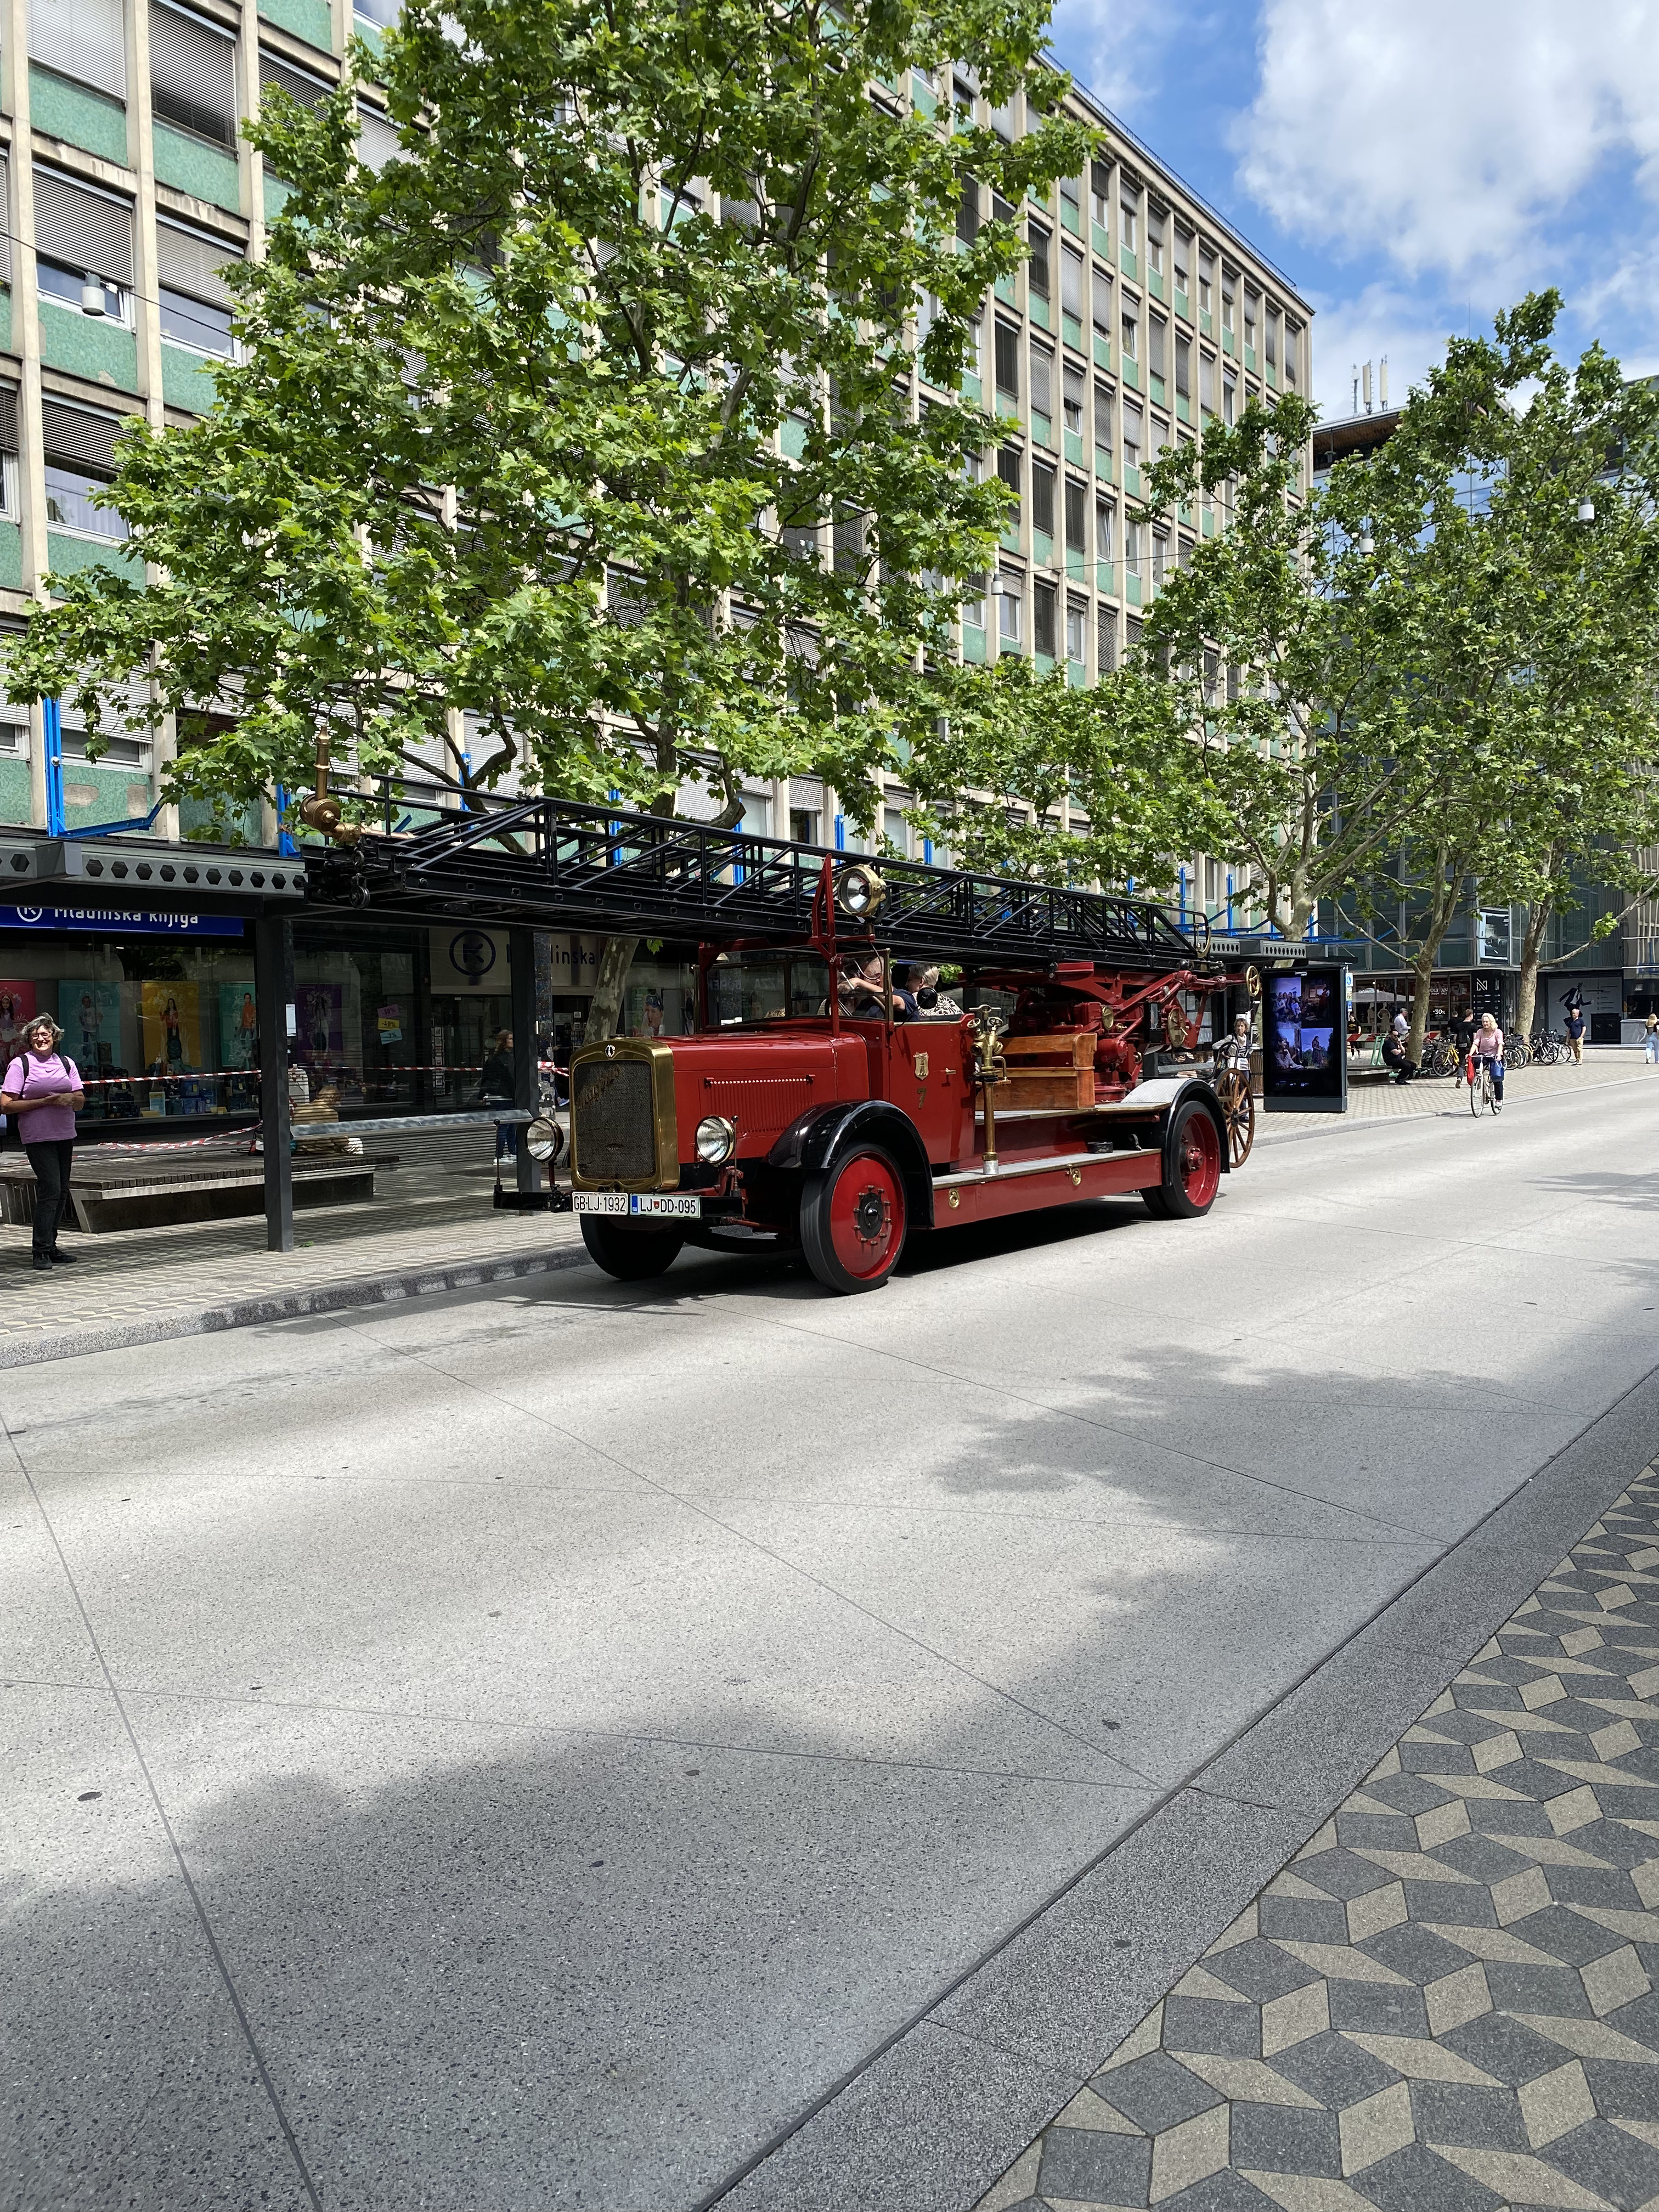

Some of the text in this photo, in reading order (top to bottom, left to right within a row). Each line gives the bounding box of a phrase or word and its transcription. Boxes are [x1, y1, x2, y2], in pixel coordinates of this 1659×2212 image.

[917, 1087, 927, 1109] 7
[640, 1198, 696, 1214] LJ DD-095
